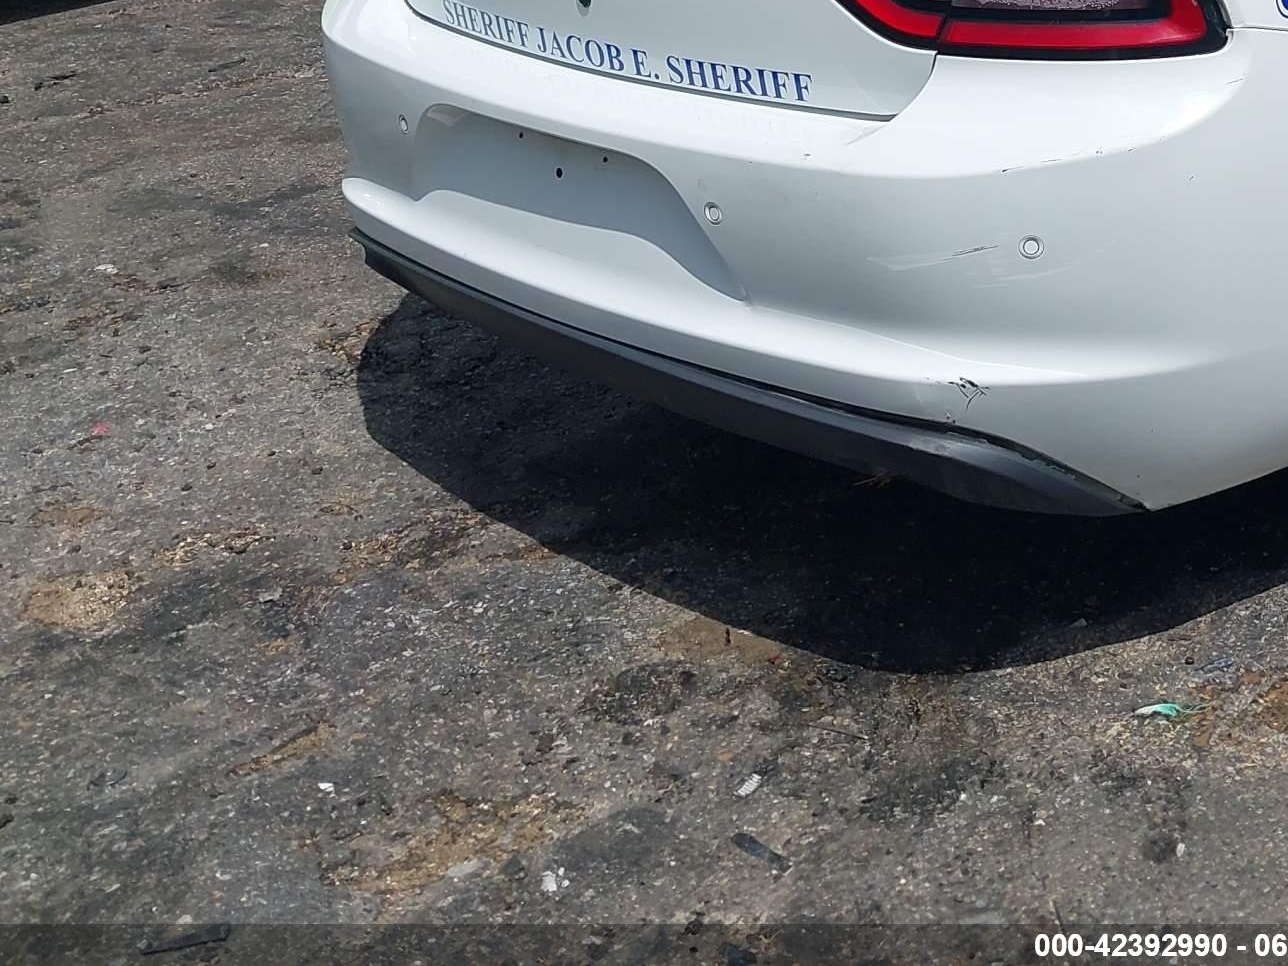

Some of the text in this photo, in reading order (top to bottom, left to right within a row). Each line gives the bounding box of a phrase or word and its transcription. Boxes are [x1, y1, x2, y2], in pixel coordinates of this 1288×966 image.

[536, 26, 624, 72] JACOB
[631, 48, 660, 80] E.
[665, 55, 812, 101] SHERIFF
